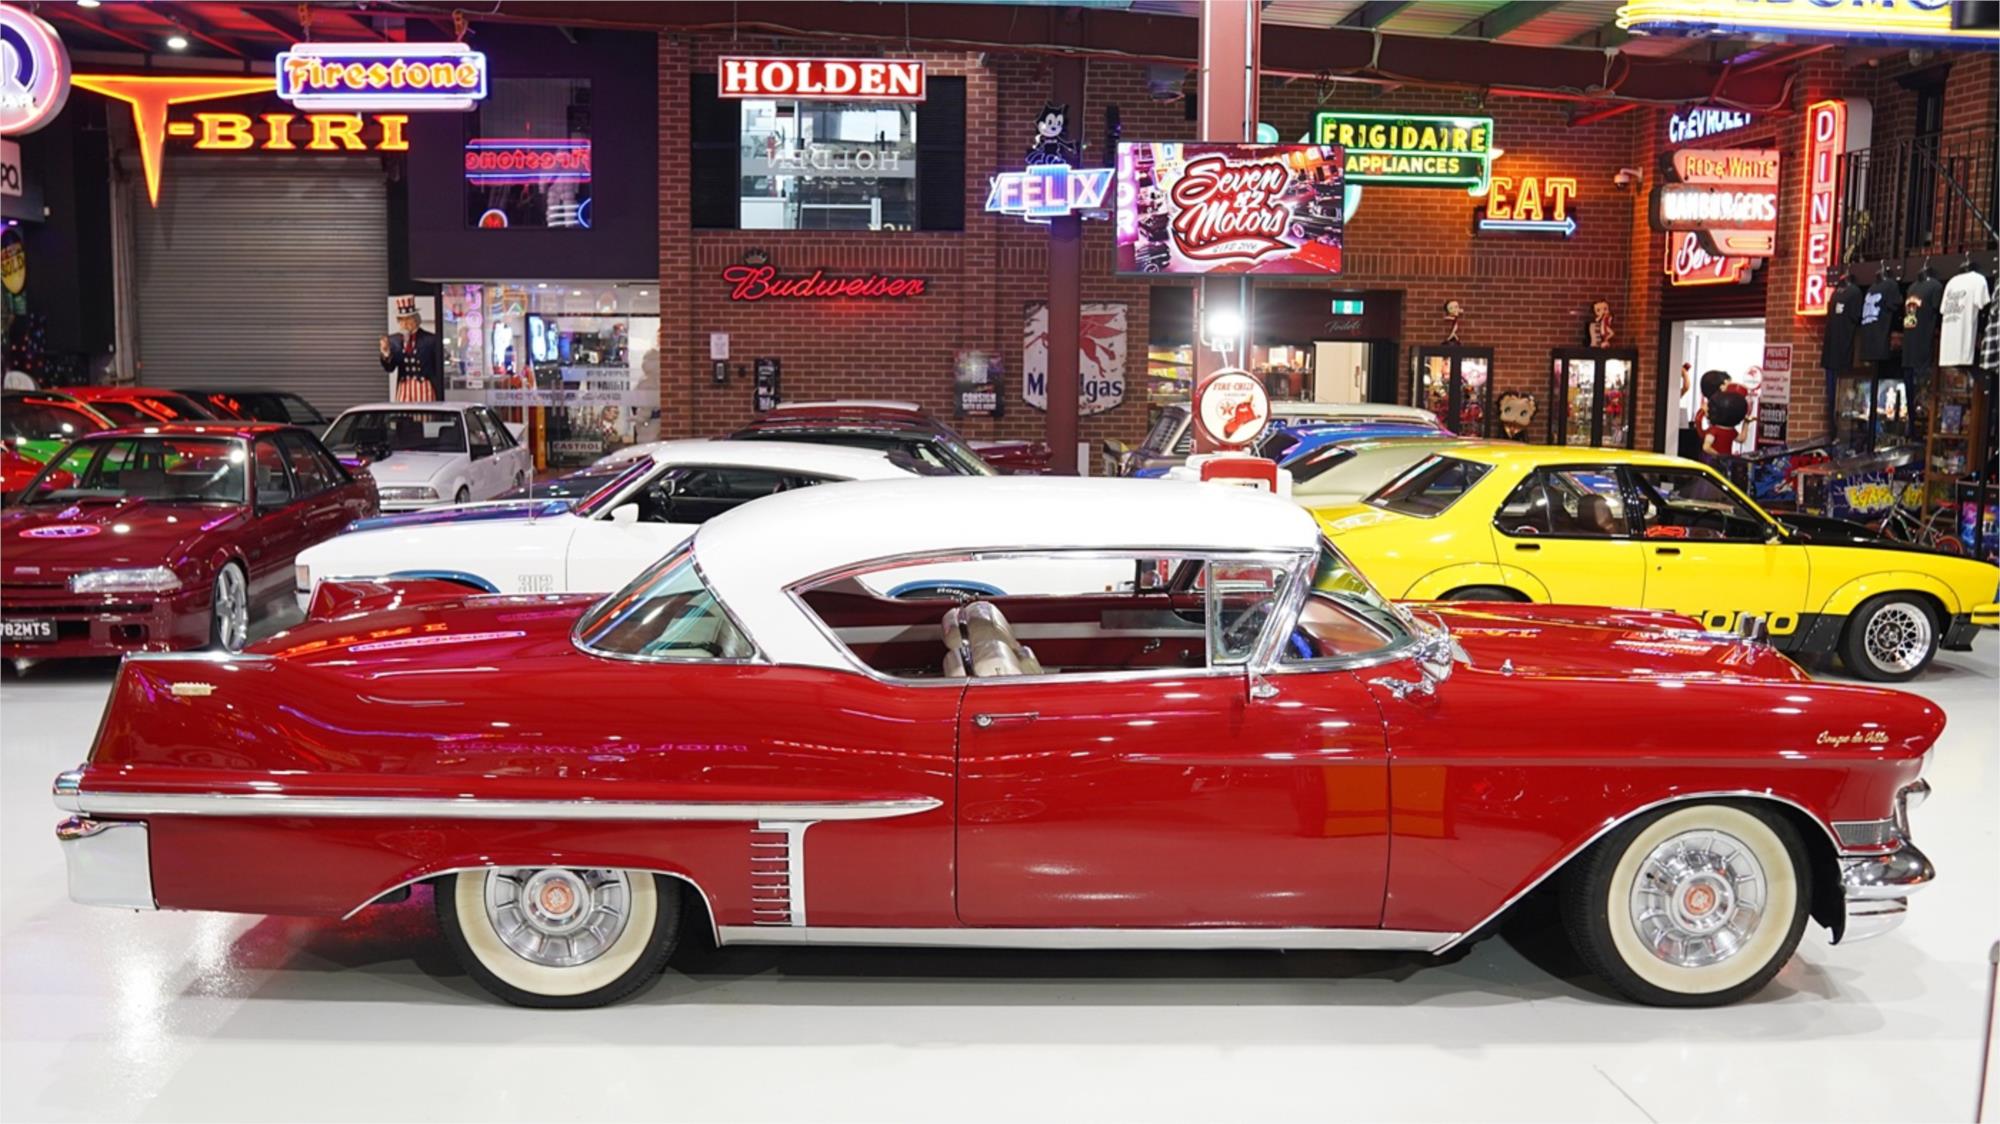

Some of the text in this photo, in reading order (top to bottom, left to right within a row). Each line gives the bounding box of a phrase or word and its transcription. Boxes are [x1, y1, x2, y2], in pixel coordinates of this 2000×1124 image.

[284, 57, 479, 93] Firestone
[724, 60, 920, 94] HOLDEN
[1323, 123, 1487, 151] FRIGIDAIRE
[1669, 109, 1751, 143] CHEVROLET
[1345, 155, 1460, 174] APPLIANCES
[1686, 156, 1714, 176] RED
[1726, 157, 1775, 177] WHITE
[1000, 174, 1099, 207] FELIX
[1176, 160, 1282, 206] Seven
[1486, 176, 1577, 221] EAT
[1177, 200, 1284, 243] Motors
[1663, 191, 1776, 221] HAMBURGERS
[1805, 110, 1834, 305] DINER
[722, 265, 926, 300] Budweiser
[1027, 373, 1122, 403] Mlgas
